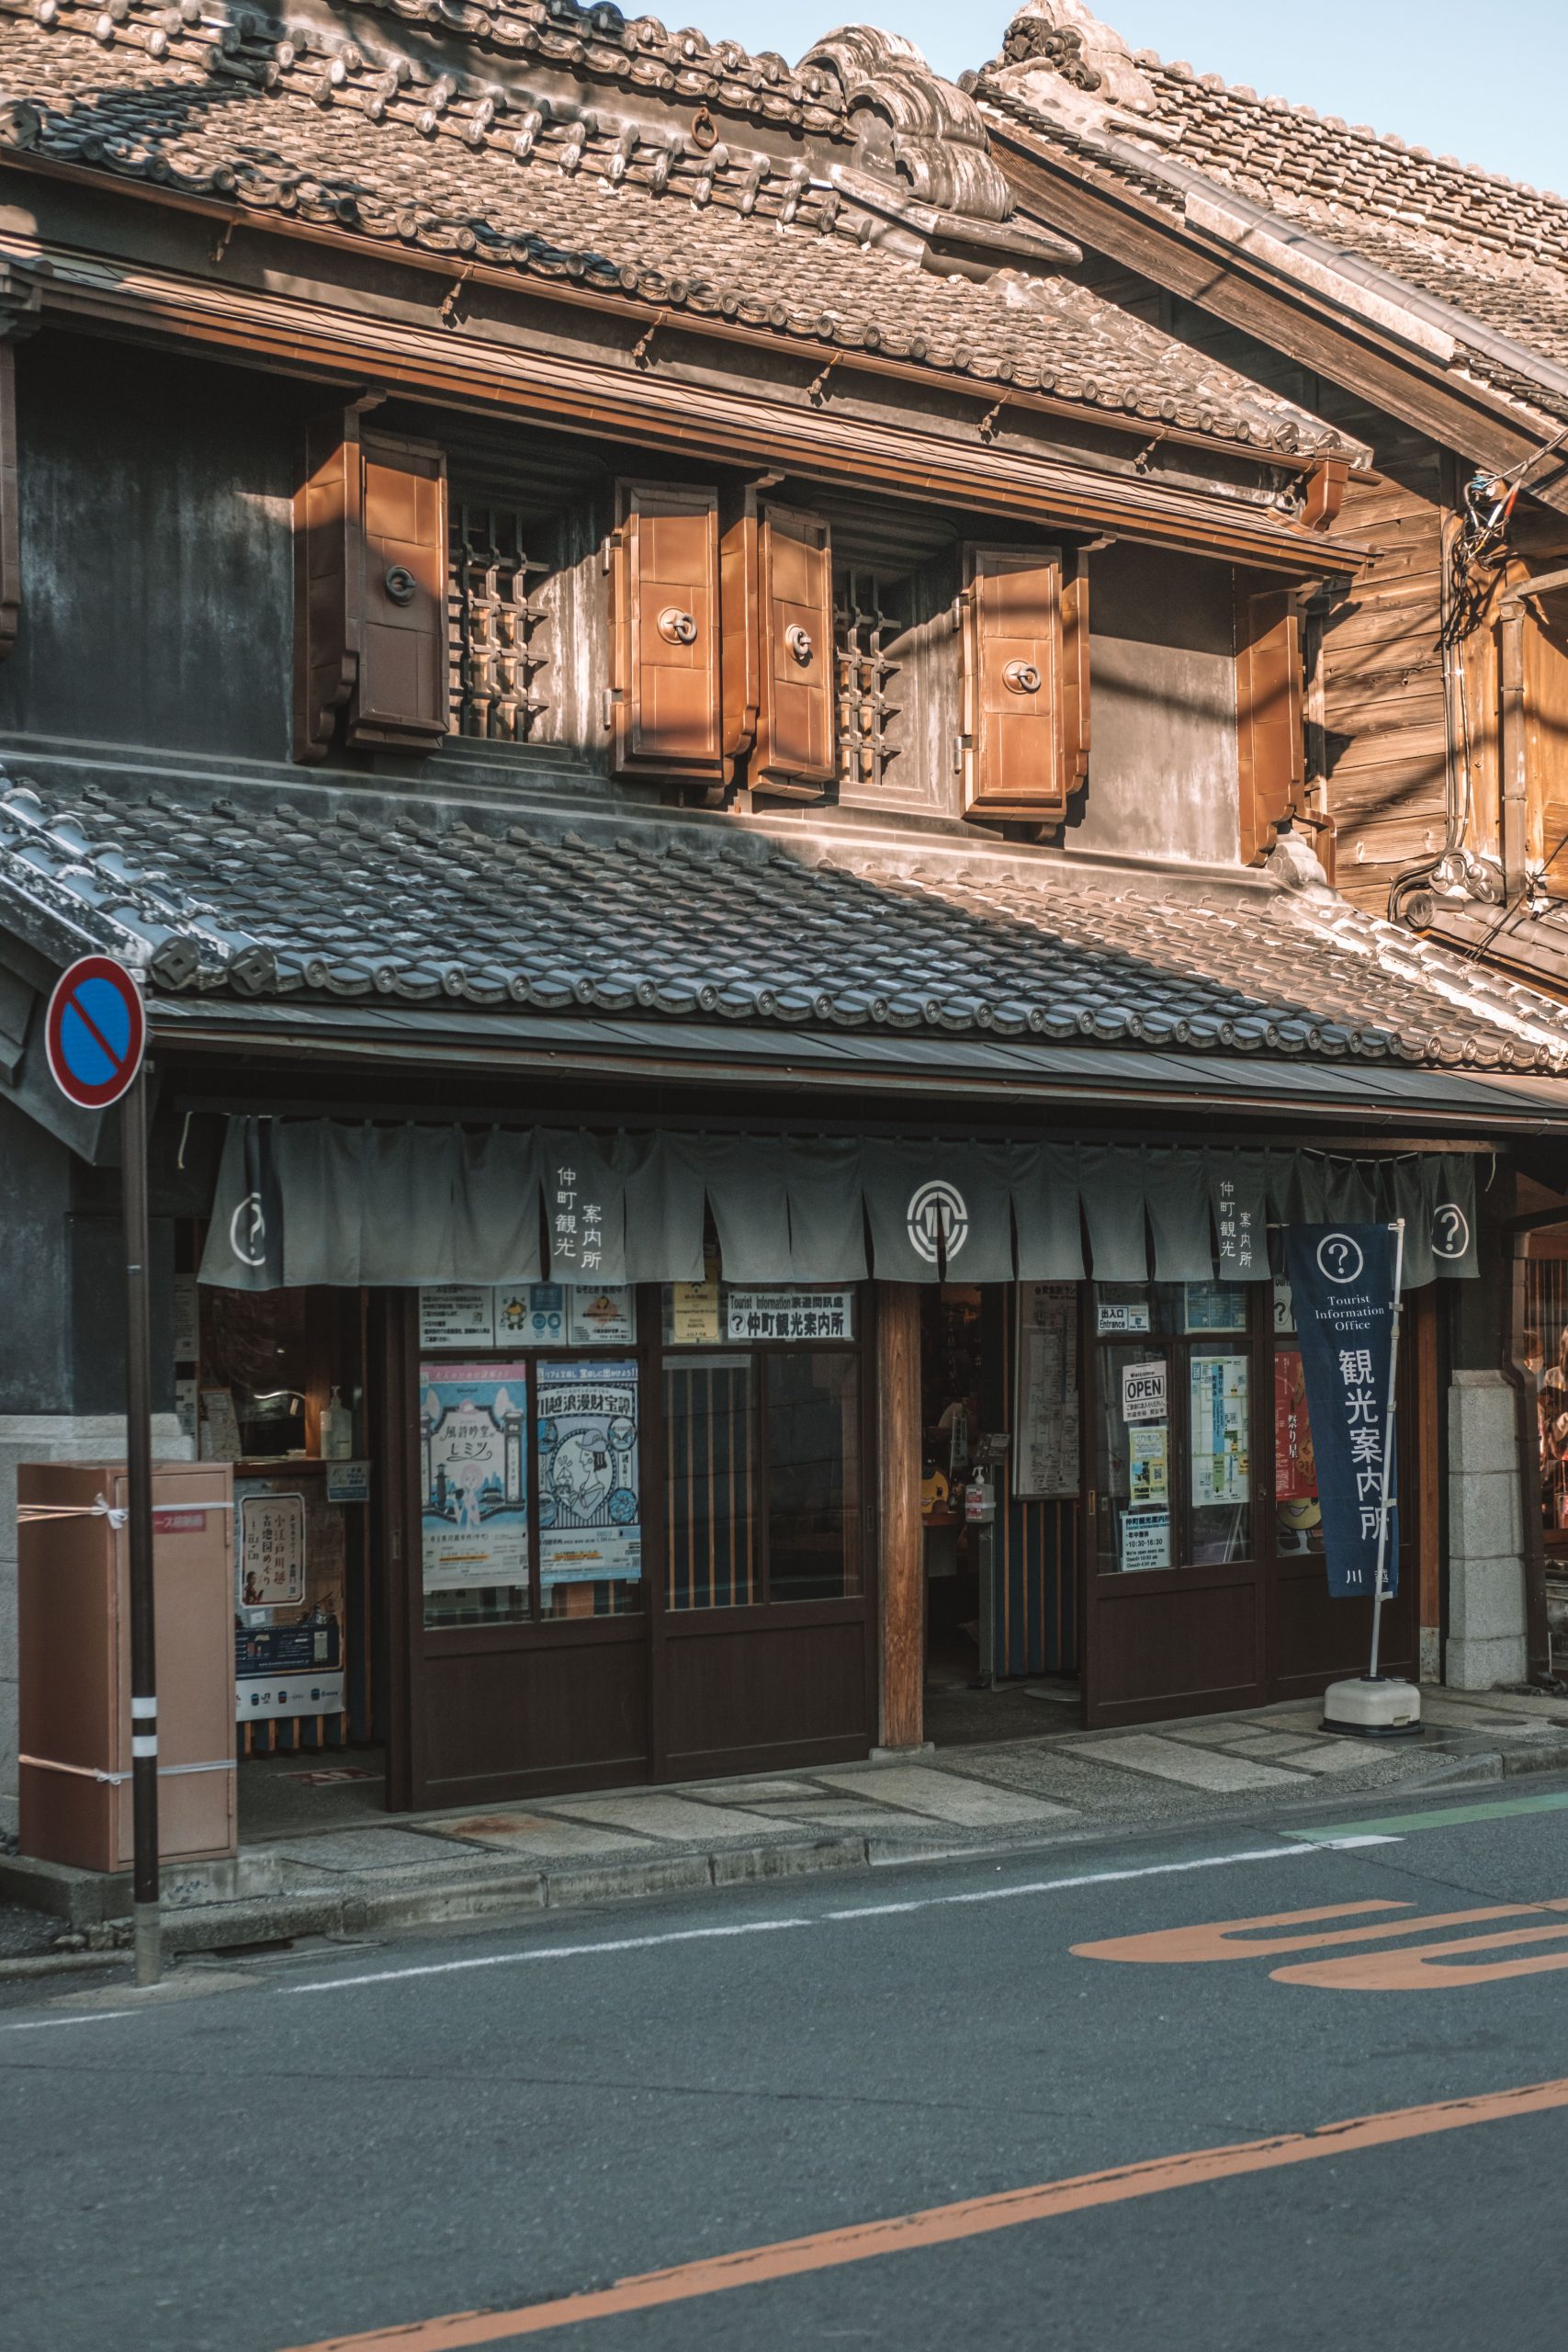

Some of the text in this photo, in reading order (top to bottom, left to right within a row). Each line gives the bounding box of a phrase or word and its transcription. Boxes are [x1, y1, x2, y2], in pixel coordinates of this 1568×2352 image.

[554, 1166, 578, 1258] 仲町観光
[1220, 1181, 1236, 1257] 仲町観光
[581, 1204, 603, 1271] 案内所
[1238, 1211, 1252, 1268] 案内所
[730, 1295, 752, 1309] Tourist
[756, 1295, 791, 1310] Information
[1326, 1294, 1371, 1306] Tourist
[747, 1312, 844, 1337] 仲町観光案内所
[1100, 1319, 1125, 1329] Entrance
[1101, 1309, 1123, 1318] 出入口
[1315, 1307, 1385, 1320] Information
[1335, 1320, 1371, 1331] Office
[1127, 1378, 1161, 1398] OPEN
[1288, 1414, 1298, 1458] 祭り星
[1338, 1349, 1390, 1543] 観光案内所
